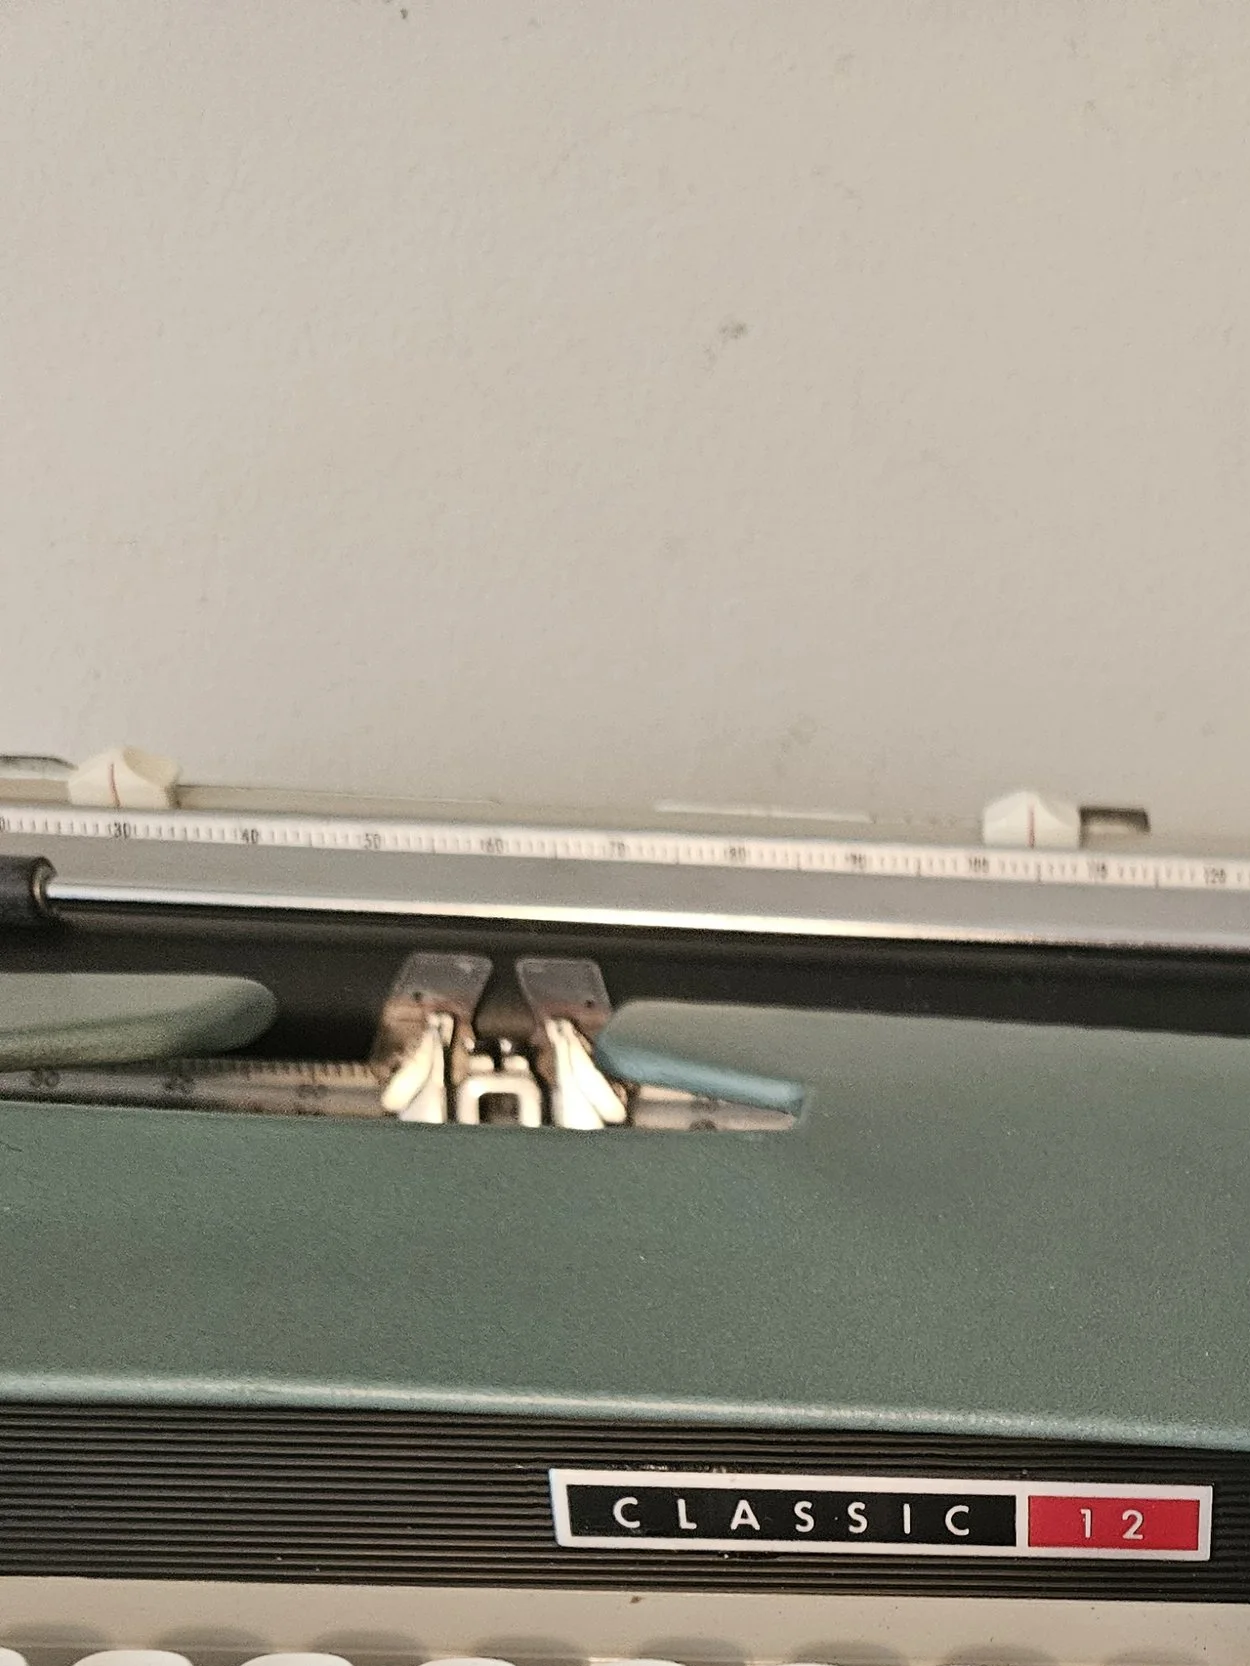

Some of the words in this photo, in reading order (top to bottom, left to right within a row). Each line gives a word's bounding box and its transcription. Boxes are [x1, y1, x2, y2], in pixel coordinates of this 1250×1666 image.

[113, 821, 131, 839] 30
[242, 828, 259, 844] 40
[364, 833, 381, 849] 50
[613, 1498, 970, 1536] CLASSIC
[1081, 1509, 1143, 1539] 12
